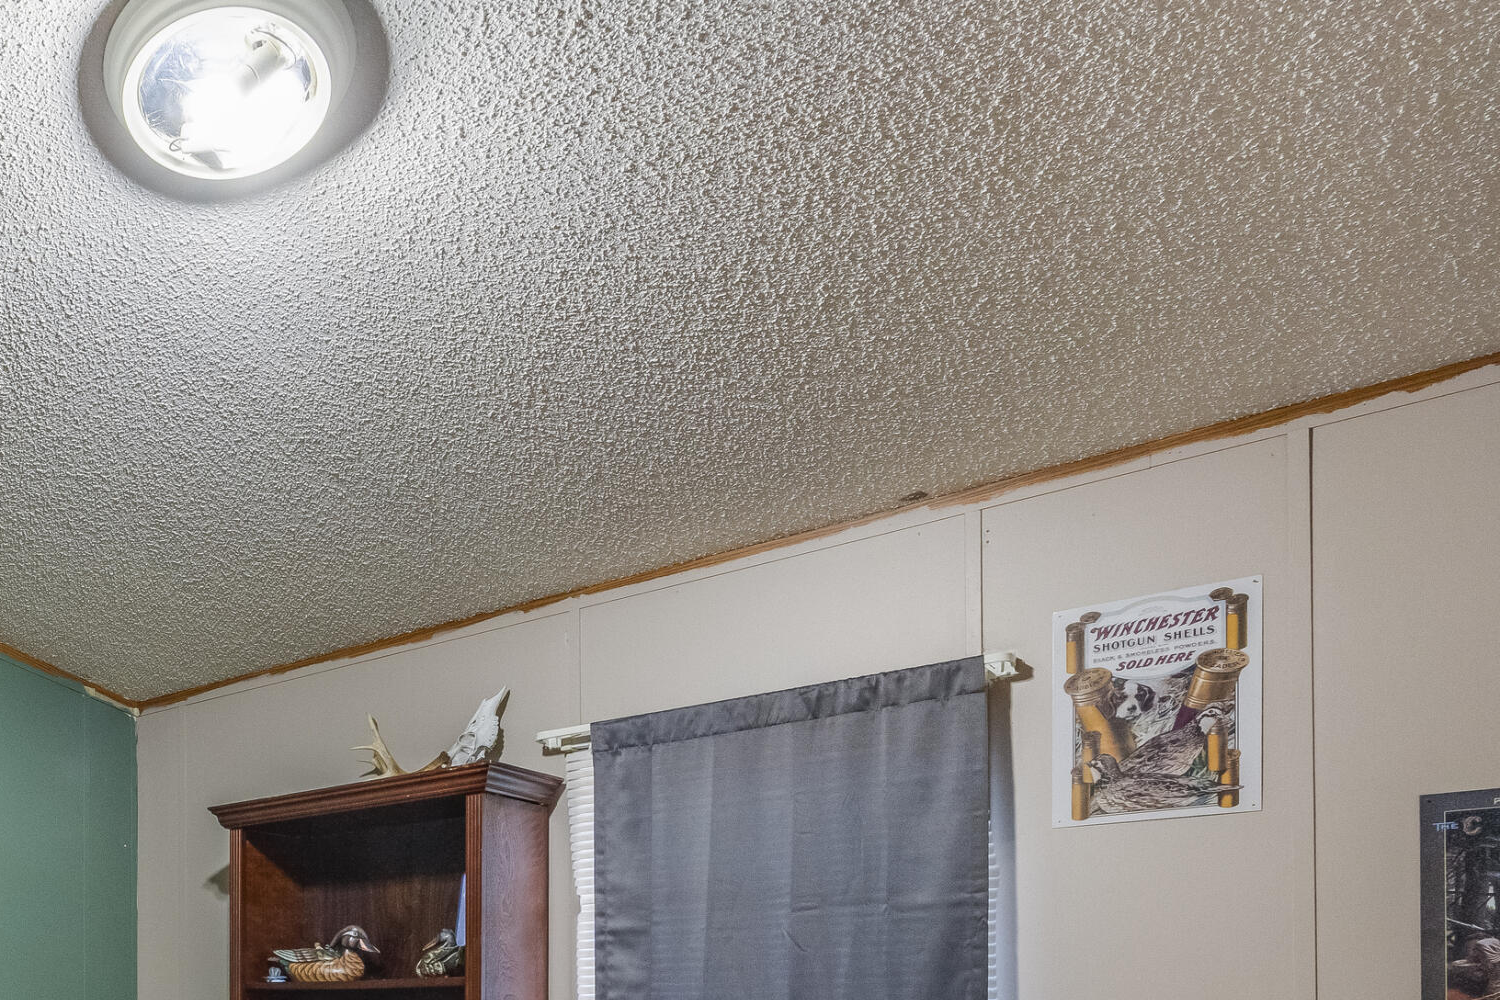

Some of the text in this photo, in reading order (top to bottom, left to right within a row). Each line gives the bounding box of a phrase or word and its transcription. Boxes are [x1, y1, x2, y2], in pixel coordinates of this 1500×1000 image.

[1090, 605, 1220, 642] WINCHESTER
[1093, 624, 1216, 653] SHOTGUN SHELLS
[1115, 655, 1152, 672] SOLD
[1154, 649, 1197, 666] HERE
